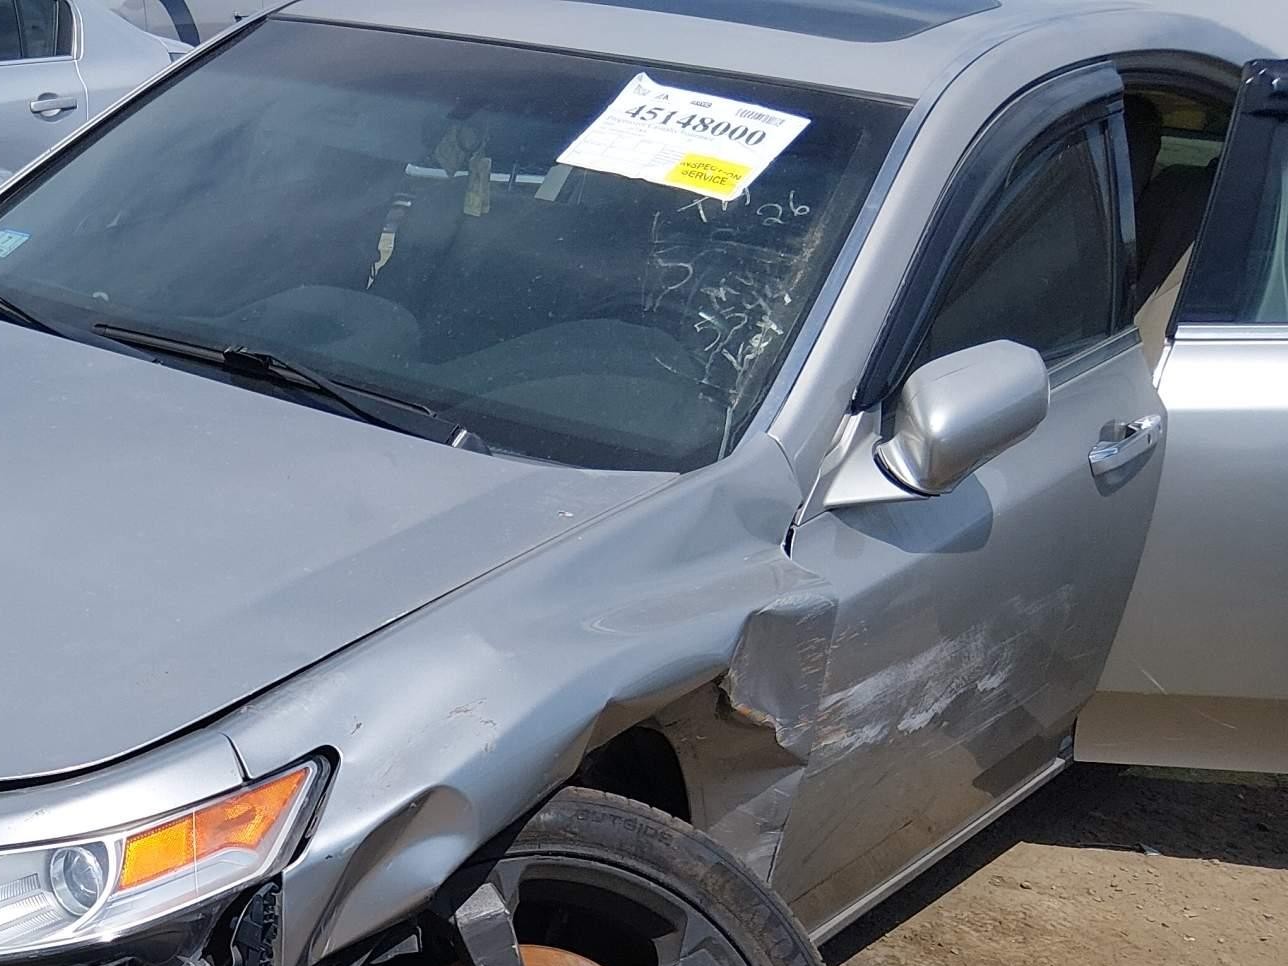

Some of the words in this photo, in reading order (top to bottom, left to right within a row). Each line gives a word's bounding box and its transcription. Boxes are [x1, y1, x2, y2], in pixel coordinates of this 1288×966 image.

[625, 105, 766, 146] 45148000
[681, 170, 728, 185] SERVICE
[576, 809, 673, 847] OUTSIDE
